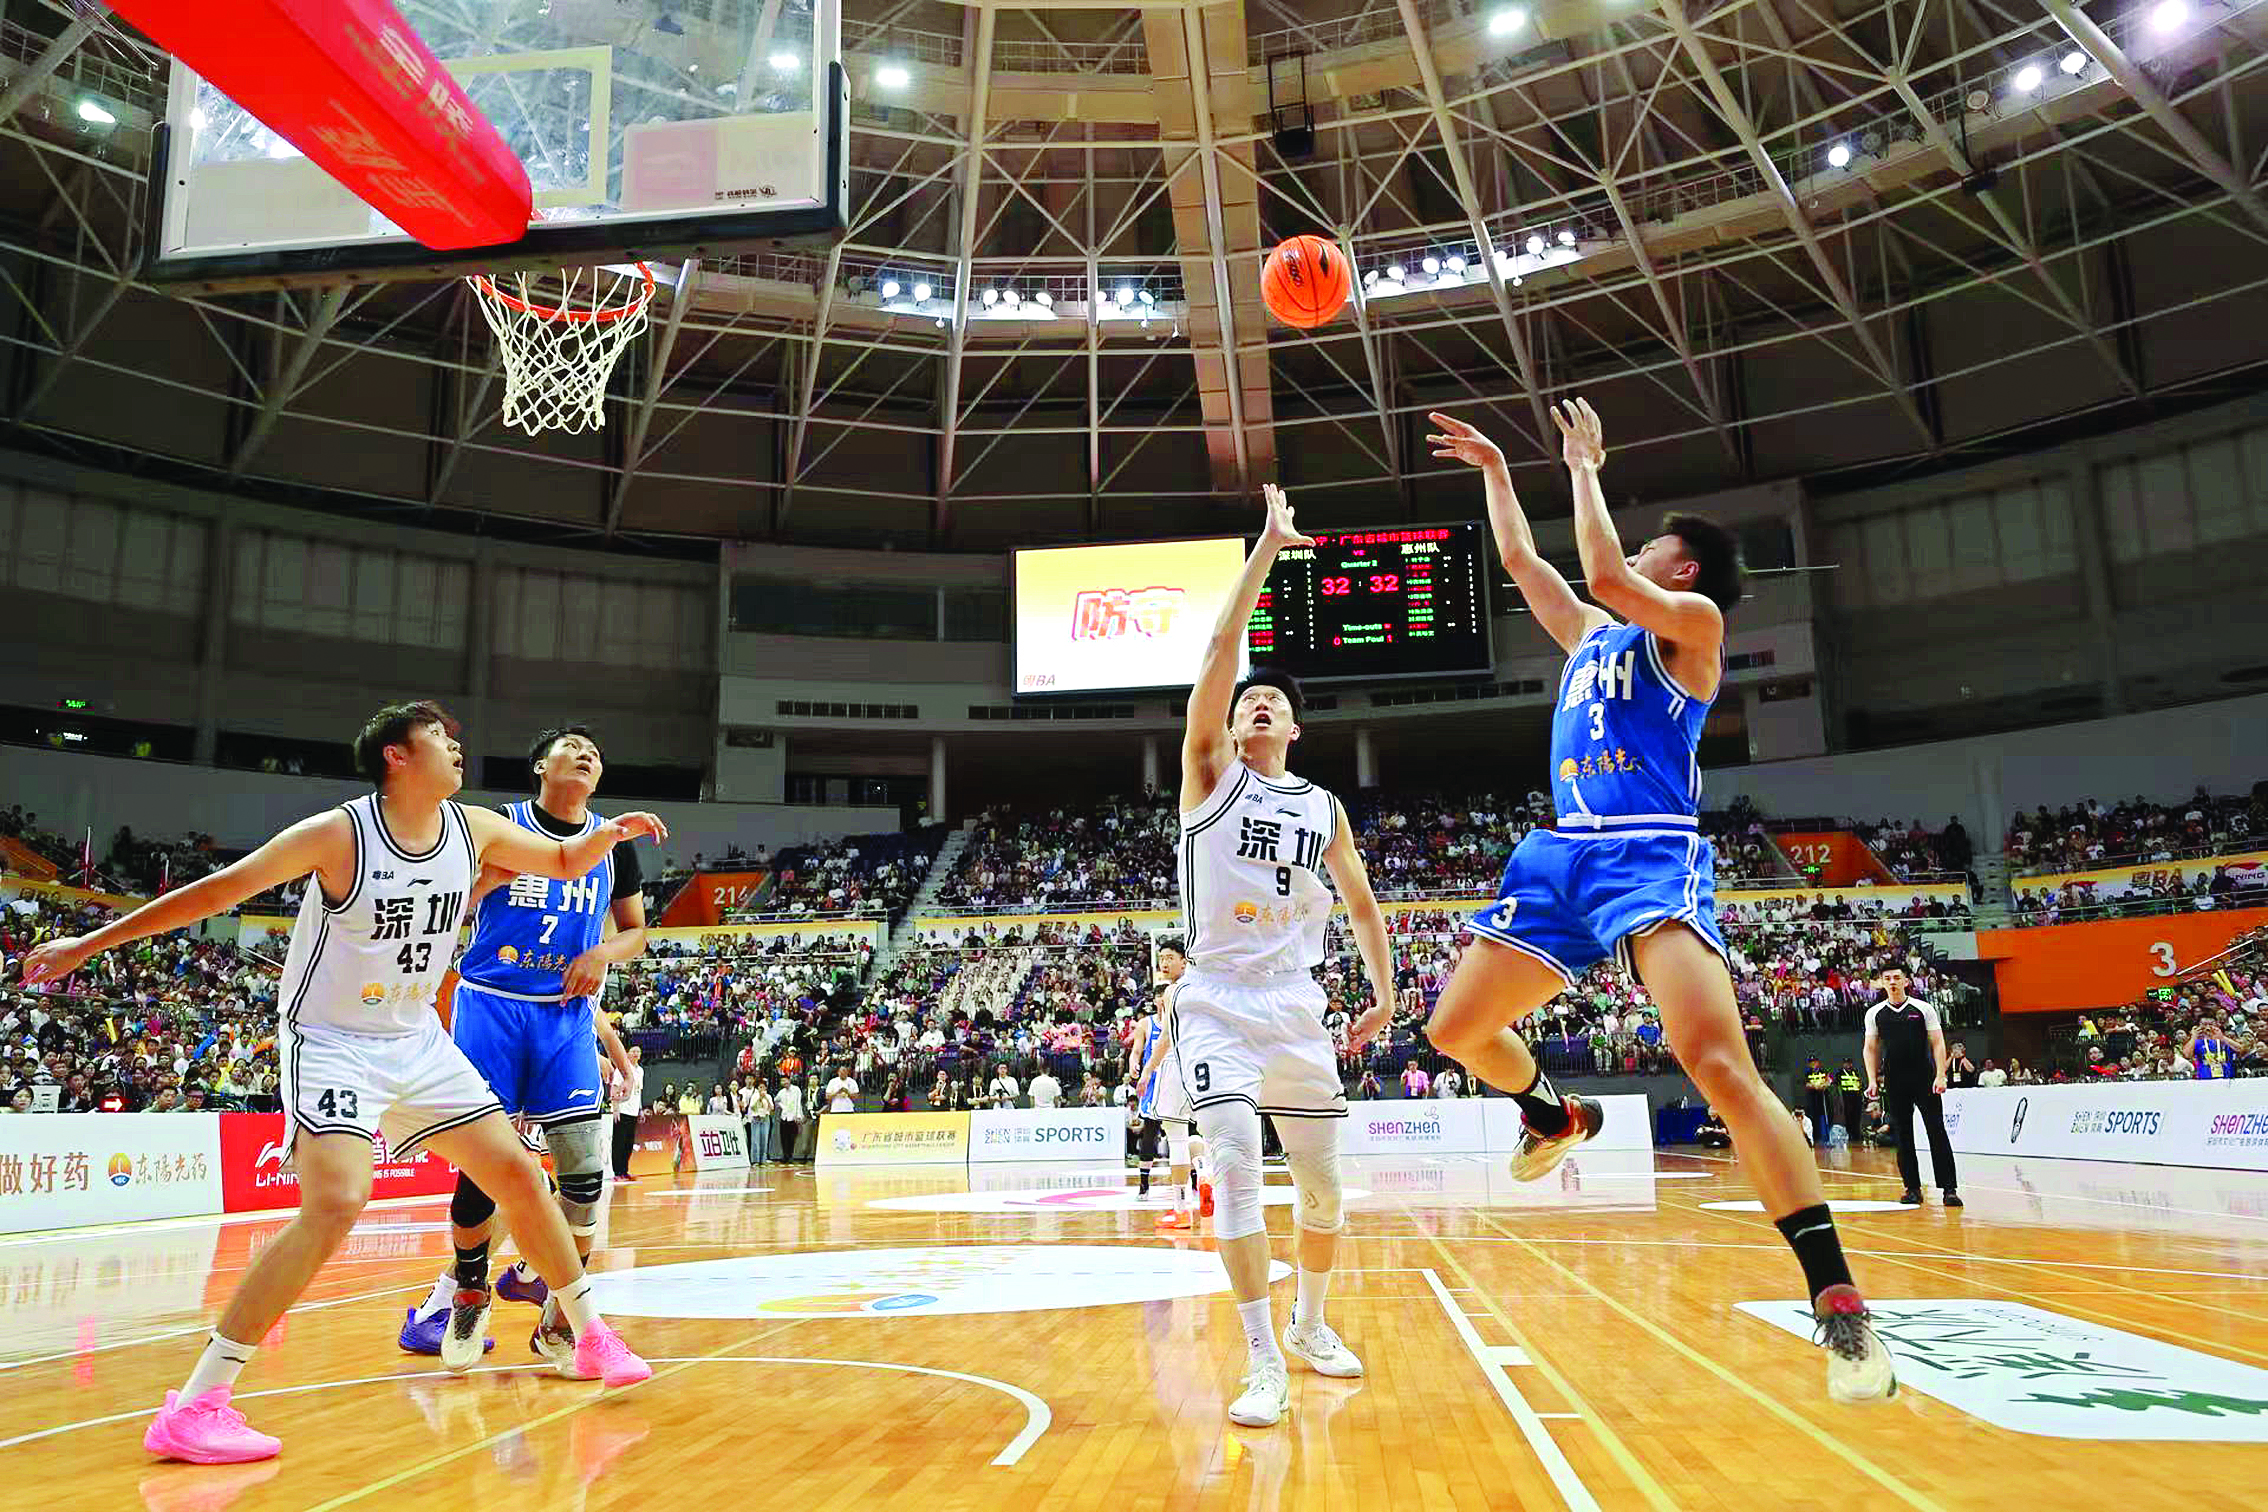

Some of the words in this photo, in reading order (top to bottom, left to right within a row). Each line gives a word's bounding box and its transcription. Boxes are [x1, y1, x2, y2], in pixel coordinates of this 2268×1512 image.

[1400, 542, 1441, 554] 惠州队
[1340, 561, 1370, 569] Quarter
[1322, 576, 1350, 595] 32
[1369, 574, 1399, 593] 32
[1365, 635, 1385, 643] Foul
[1562, 650, 1635, 712] 惠州
[1588, 702, 1605, 741] 3
[1236, 816, 1327, 873] 深圳
[1790, 844, 1832, 864] 212
[508, 872, 601, 915] 惠州
[1276, 866, 1291, 896] 9
[371, 891, 463, 940] 深圳
[1490, 896, 1518, 930] 3
[538, 915, 559, 944] 7
[397, 943, 432, 974] 43
[2149, 942, 2176, 977] 3
[1194, 1062, 1210, 1093] 9
[317, 1088, 359, 1118] 43
[1034, 1127, 1105, 1143] SPORTS
[2104, 1111, 2161, 1135] SPORTS
[255, 1172, 299, 1187] LI-NIN
